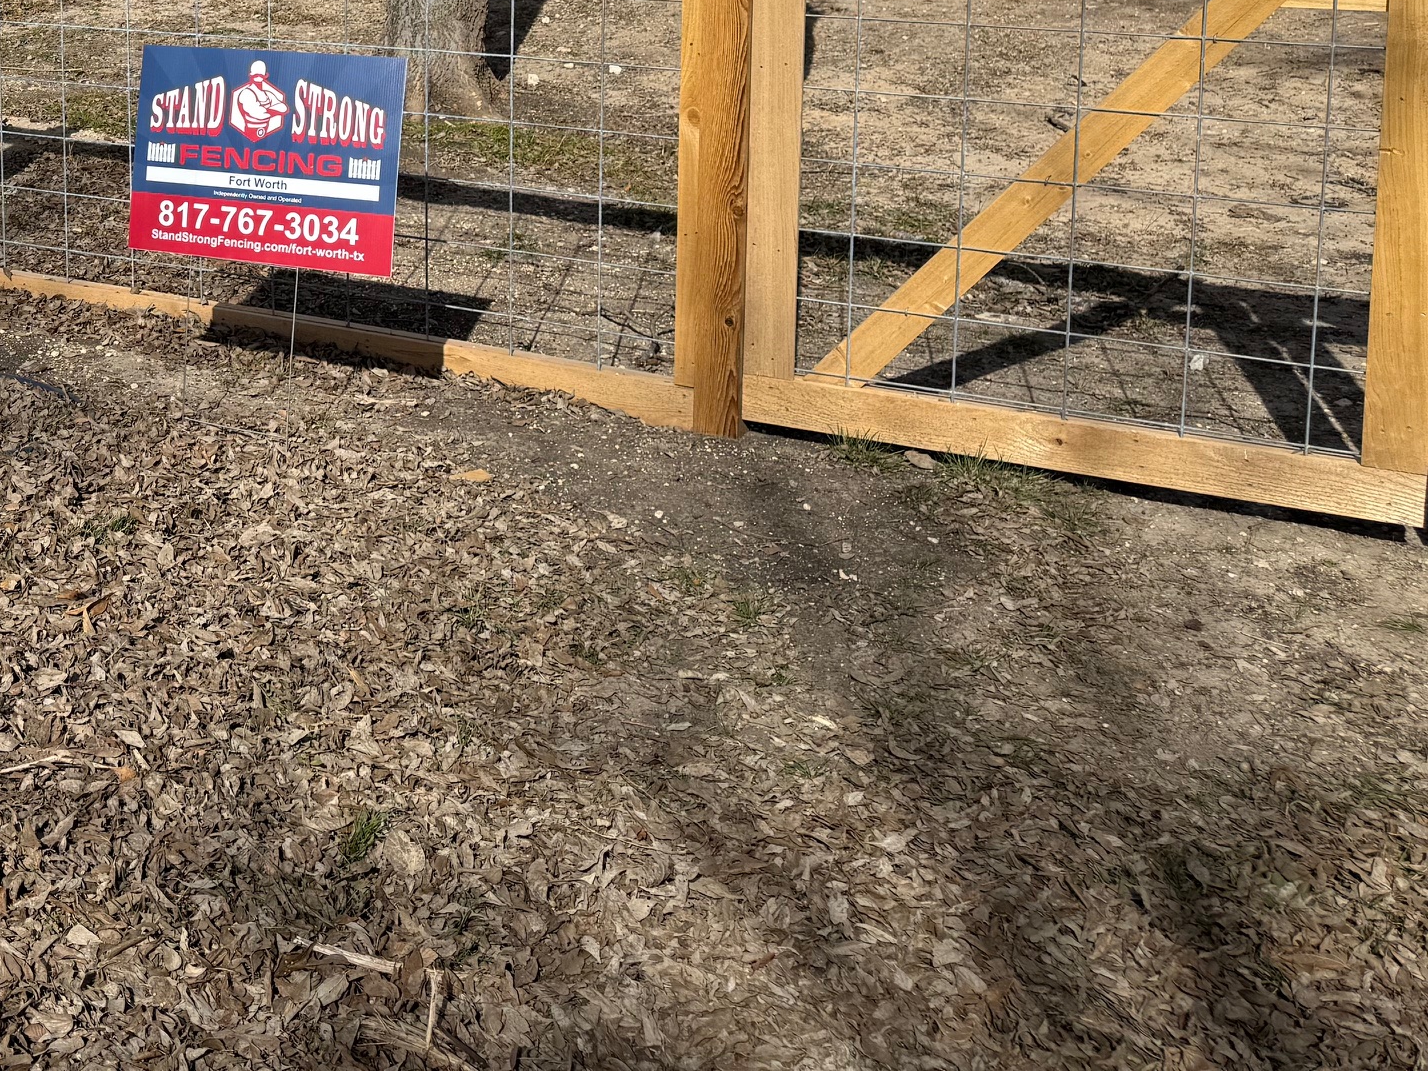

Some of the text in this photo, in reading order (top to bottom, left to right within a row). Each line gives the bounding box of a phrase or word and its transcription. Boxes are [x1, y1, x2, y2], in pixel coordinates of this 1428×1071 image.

[150, 76, 386, 149] STAND STRONG
[178, 143, 343, 177] FENCING
[213, 190, 248, 200] Independently
[248, 192, 266, 201] Owned
[278, 195, 302, 205] Operated
[229, 175, 288, 191] Fort Worth
[158, 199, 360, 246] 817-767-3034
[151, 228, 365, 262] StandStrongFencing.com/fort-worth-tx
